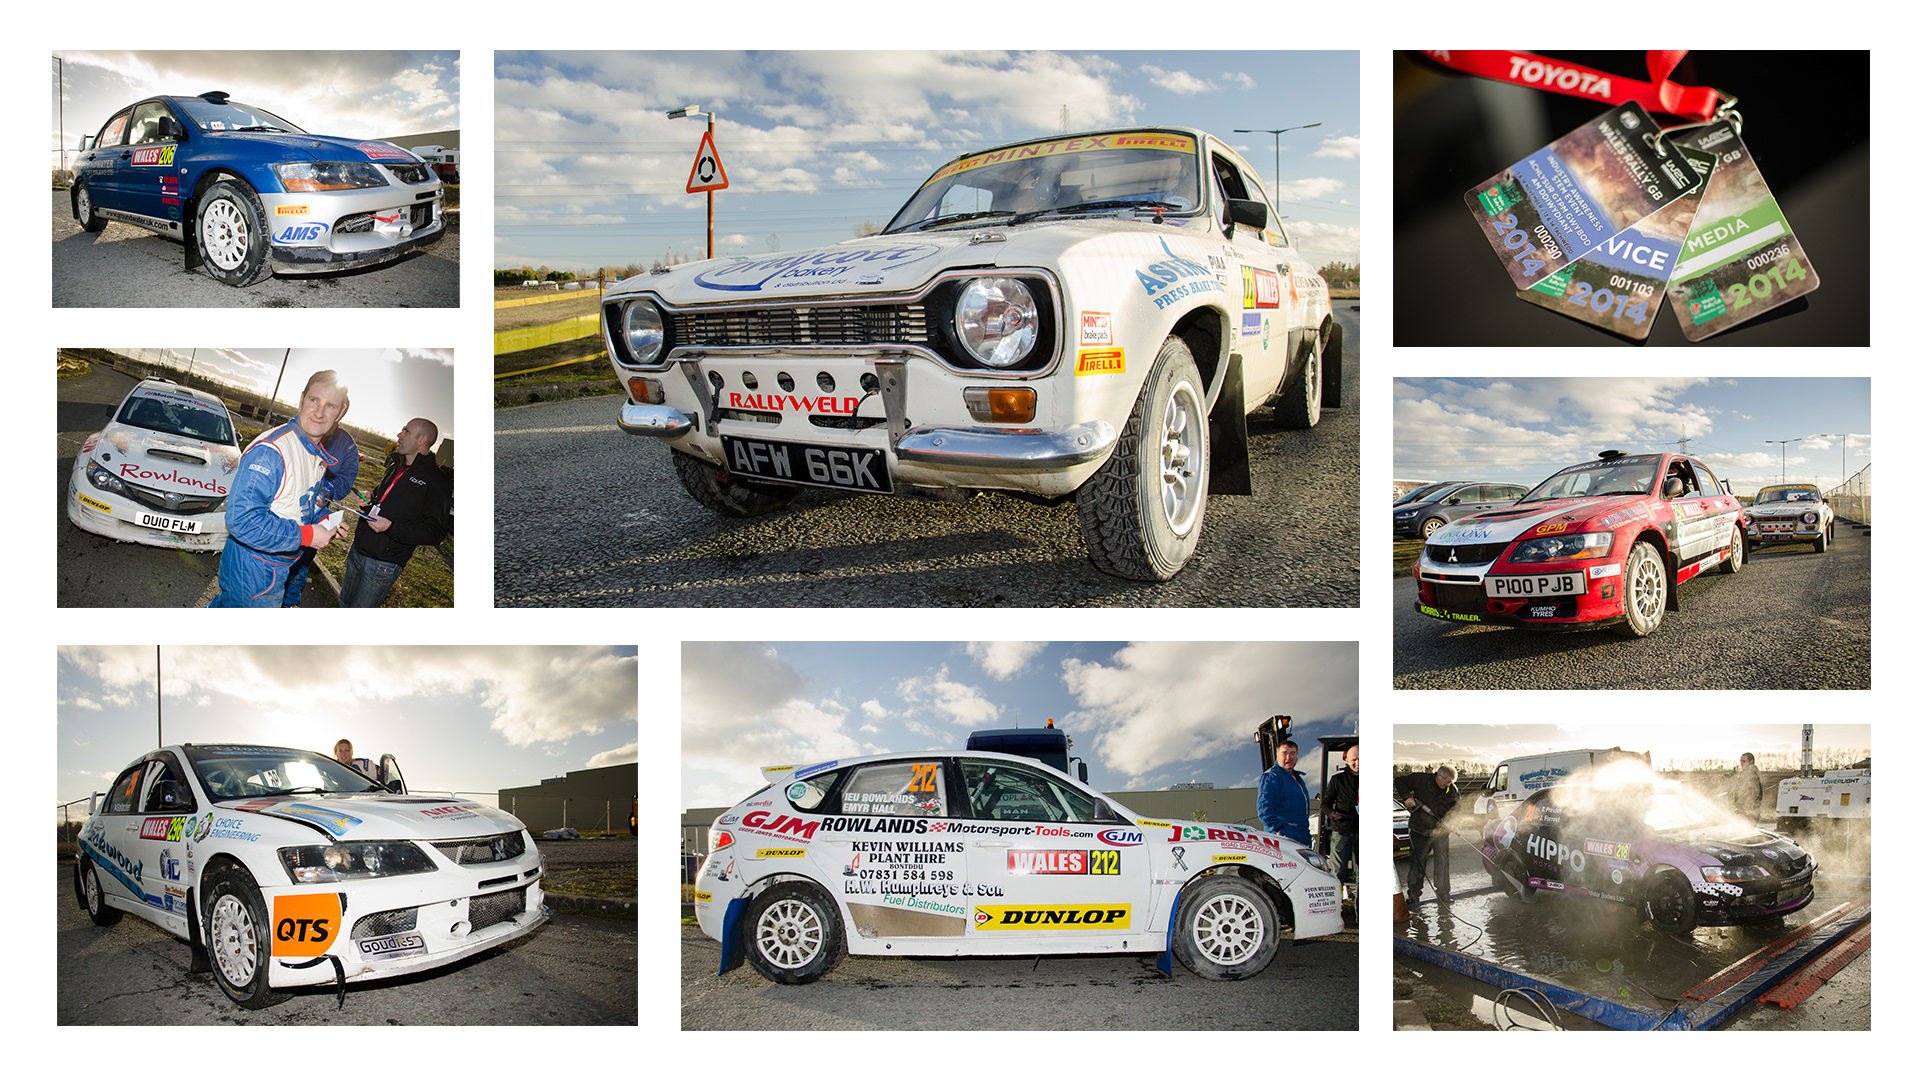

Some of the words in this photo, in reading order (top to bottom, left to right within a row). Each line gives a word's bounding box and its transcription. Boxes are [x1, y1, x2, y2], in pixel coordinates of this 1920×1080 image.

[1509, 56, 1612, 98] TOYOTA
[1117, 136, 1187, 148] PIRELLI
[1697, 126, 1731, 146] WRC
[133, 148, 159, 163] WALES
[159, 145, 176, 165] 206
[982, 137, 1110, 165] MINTEX
[1598, 121, 1628, 156] WALES
[1623, 153, 1652, 185] RALLY
[1647, 184, 1663, 201] GB
[1722, 150, 1742, 164] GB
[1665, 159, 1690, 187] WRC
[1528, 159, 1554, 194] ACHLYSUR
[1552, 192, 1568, 213] GTPM
[1565, 213, 1592, 247] GWYBOD
[1547, 155, 1573, 191] INDUSTRY
[1570, 188, 1604, 232] AWARENESS
[1551, 174, 1567, 195] STEM
[1564, 194, 1584, 218] EVENT
[277, 205, 307, 215] PIRELLI
[1531, 177, 1541, 190] AM
[1538, 187, 1573, 235] DDIWYDIANT
[280, 227, 320, 240] AMS
[1533, 224, 1563, 260] 000290
[1686, 218, 1750, 253] MEDIA
[1493, 214, 1546, 277] 2014
[1595, 236, 1669, 270] VICE
[1746, 244, 1790, 270] 000236
[781, 264, 857, 279] bakery
[782, 279, 829, 288] distribution
[1255, 273, 1279, 304] WALES
[1610, 274, 1654, 297] 001103
[1728, 258, 1807, 309] 2014
[1153, 285, 1190, 310] PRESS
[1189, 280, 1212, 294] BRAKE
[1568, 281, 1649, 325] 2014
[1084, 330, 1097, 340] brake
[1097, 331, 1109, 342] pads
[1078, 351, 1122, 371] PIRELLI
[730, 392, 859, 414] RALLYWELD
[732, 439, 793, 478] AFW
[805, 448, 880, 489] 66K
[120, 463, 227, 495] Rowlands
[82, 497, 111, 511] DUNLOP
[142, 514, 170, 529] OU10
[1536, 523, 1568, 534] GPM
[1495, 578, 1534, 594] P100
[908, 763, 938, 792] 212
[842, 803, 869, 813] EMYR
[872, 803, 896, 814] HALL
[861, 793, 915, 804] ROWLANDS
[142, 819, 168, 836] WALES
[167, 816, 186, 842] 296
[215, 817, 243, 830] CHOICE
[720, 815, 740, 824] GJM
[742, 811, 821, 840] GJM
[820, 818, 929, 834] ROWLANDS
[946, 822, 1094, 838] Motorsport-Tools.com
[210, 828, 261, 843] ENGINEERING
[773, 833, 811, 845] MOTORSPORT
[1105, 830, 1142, 843] GJM
[1167, 825, 1281, 851] JORDAN
[1220, 841, 1239, 849] ROAD
[852, 841, 892, 852] KEVIN
[896, 842, 965, 853] WILLIAMS
[1527, 833, 1586, 872] HIPPO
[1587, 840, 1614, 855] WALES
[1615, 843, 1629, 859] 218
[869, 853, 911, 863] PLANT
[914, 853, 946, 864] HIRE
[1014, 852, 1083, 873] WALES
[1091, 850, 1119, 875] 212
[1533, 859, 1558, 872] MOTOR
[860, 869, 898, 880] 07831
[903, 870, 926, 880] 584
[930, 870, 954, 881] 598
[845, 879, 876, 894] H.W.
[880, 881, 959, 898] Humphreys
[962, 881, 974, 895] &
[977, 881, 1005, 897] Son
[1601, 892, 1616, 901] Bodies
[883, 894, 905, 906] Fuel
[907, 897, 966, 915] Distributors
[1000, 909, 1127, 925] DUNLOP
[277, 917, 329, 943] QTS
